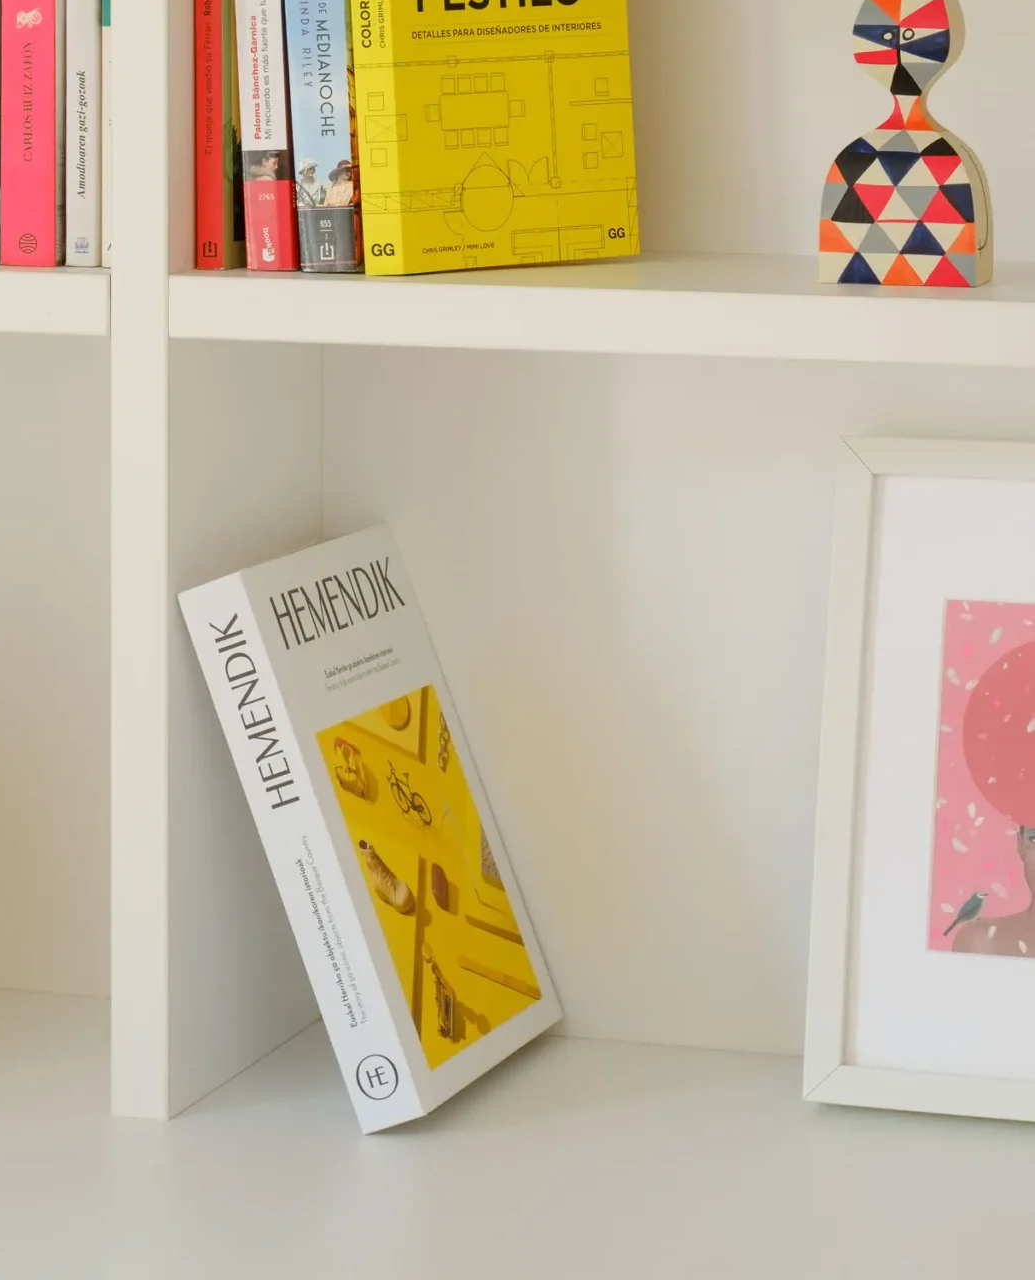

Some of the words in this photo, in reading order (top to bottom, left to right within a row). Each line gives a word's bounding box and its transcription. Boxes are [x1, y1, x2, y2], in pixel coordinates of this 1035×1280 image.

[261, 8, 269, 25] que
[318, 2, 327, 14] DE
[260, 27, 269, 52] fuerte
[378, 24, 386, 48] CHRIS
[411, 28, 452, 40] DETALLES
[452, 26, 475, 38] PARA
[476, 22, 537, 36] DISEÑADORES
[538, 24, 550, 33] DE
[551, 21, 602, 32] INTERIORES
[20, 42, 33, 81] ZAFÓN
[205, 52, 213, 63] su
[249, 15, 260, 100] Sánchez-Garnica
[262, 54, 270, 73] más
[302, 47, 314, 87] RILEY
[264, 74, 270, 86] es
[316, 19, 335, 137] MEDIANOCHE
[23, 83, 33, 112] RUIZ
[75, 69, 88, 133] gazi-gozoak
[205, 97, 214, 113] que
[264, 88, 272, 127] recuerdo
[205, 114, 214, 144] monje
[254, 102, 262, 140] Paloma
[264, 130, 272, 140] Mi
[23, 115, 33, 162] CARLOS
[76, 133, 86, 199] Amodioaren
[258, 193, 275, 201] 2765
[262, 227, 274, 256] booket
[608, 228, 626, 239] GG
[371, 243, 395, 257] GG
[438, 245, 462, 253] GRIMLEY
[269, 556, 406, 650] HEMENDIK
[208, 612, 301, 810] HEMENDIK
[301, 835, 316, 865] Country
[295, 859, 313, 891] istorioak
[309, 892, 327, 932] ikonikoren
[326, 907, 336, 926] from
[322, 932, 336, 962] objektu
[333, 962, 341, 972] 50
[335, 973, 350, 1001] Herriko
[343, 1000, 358, 1029] Euskal
